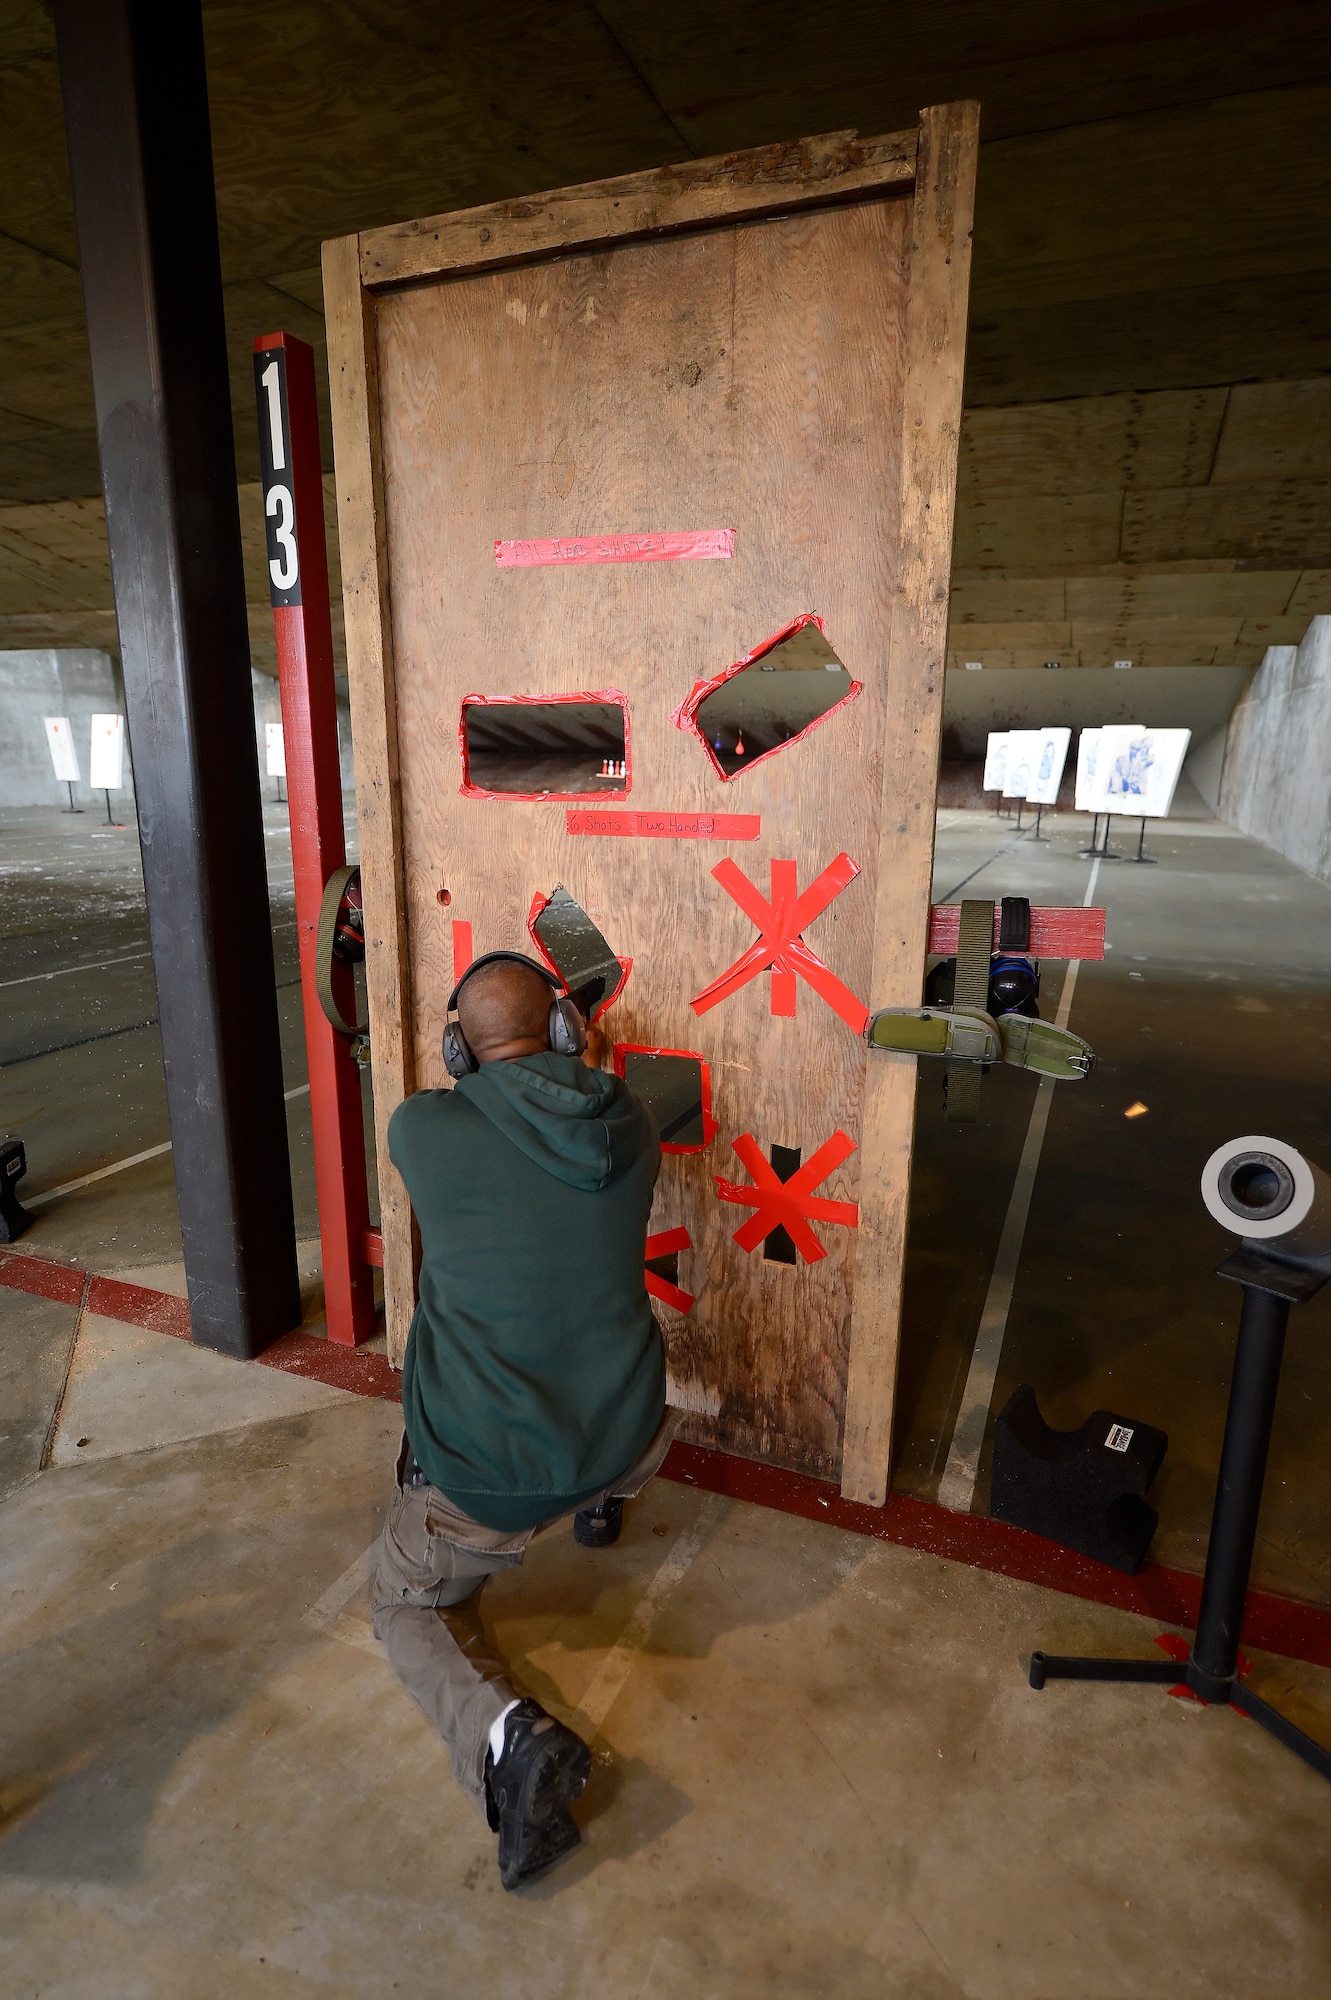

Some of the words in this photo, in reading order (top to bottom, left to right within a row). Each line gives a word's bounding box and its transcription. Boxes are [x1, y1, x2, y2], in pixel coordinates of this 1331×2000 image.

[262, 361, 298, 590] 13
[569, 814, 580, 831] 6
[585, 815, 622, 831] Shots
[634, 815, 665, 831] Two
